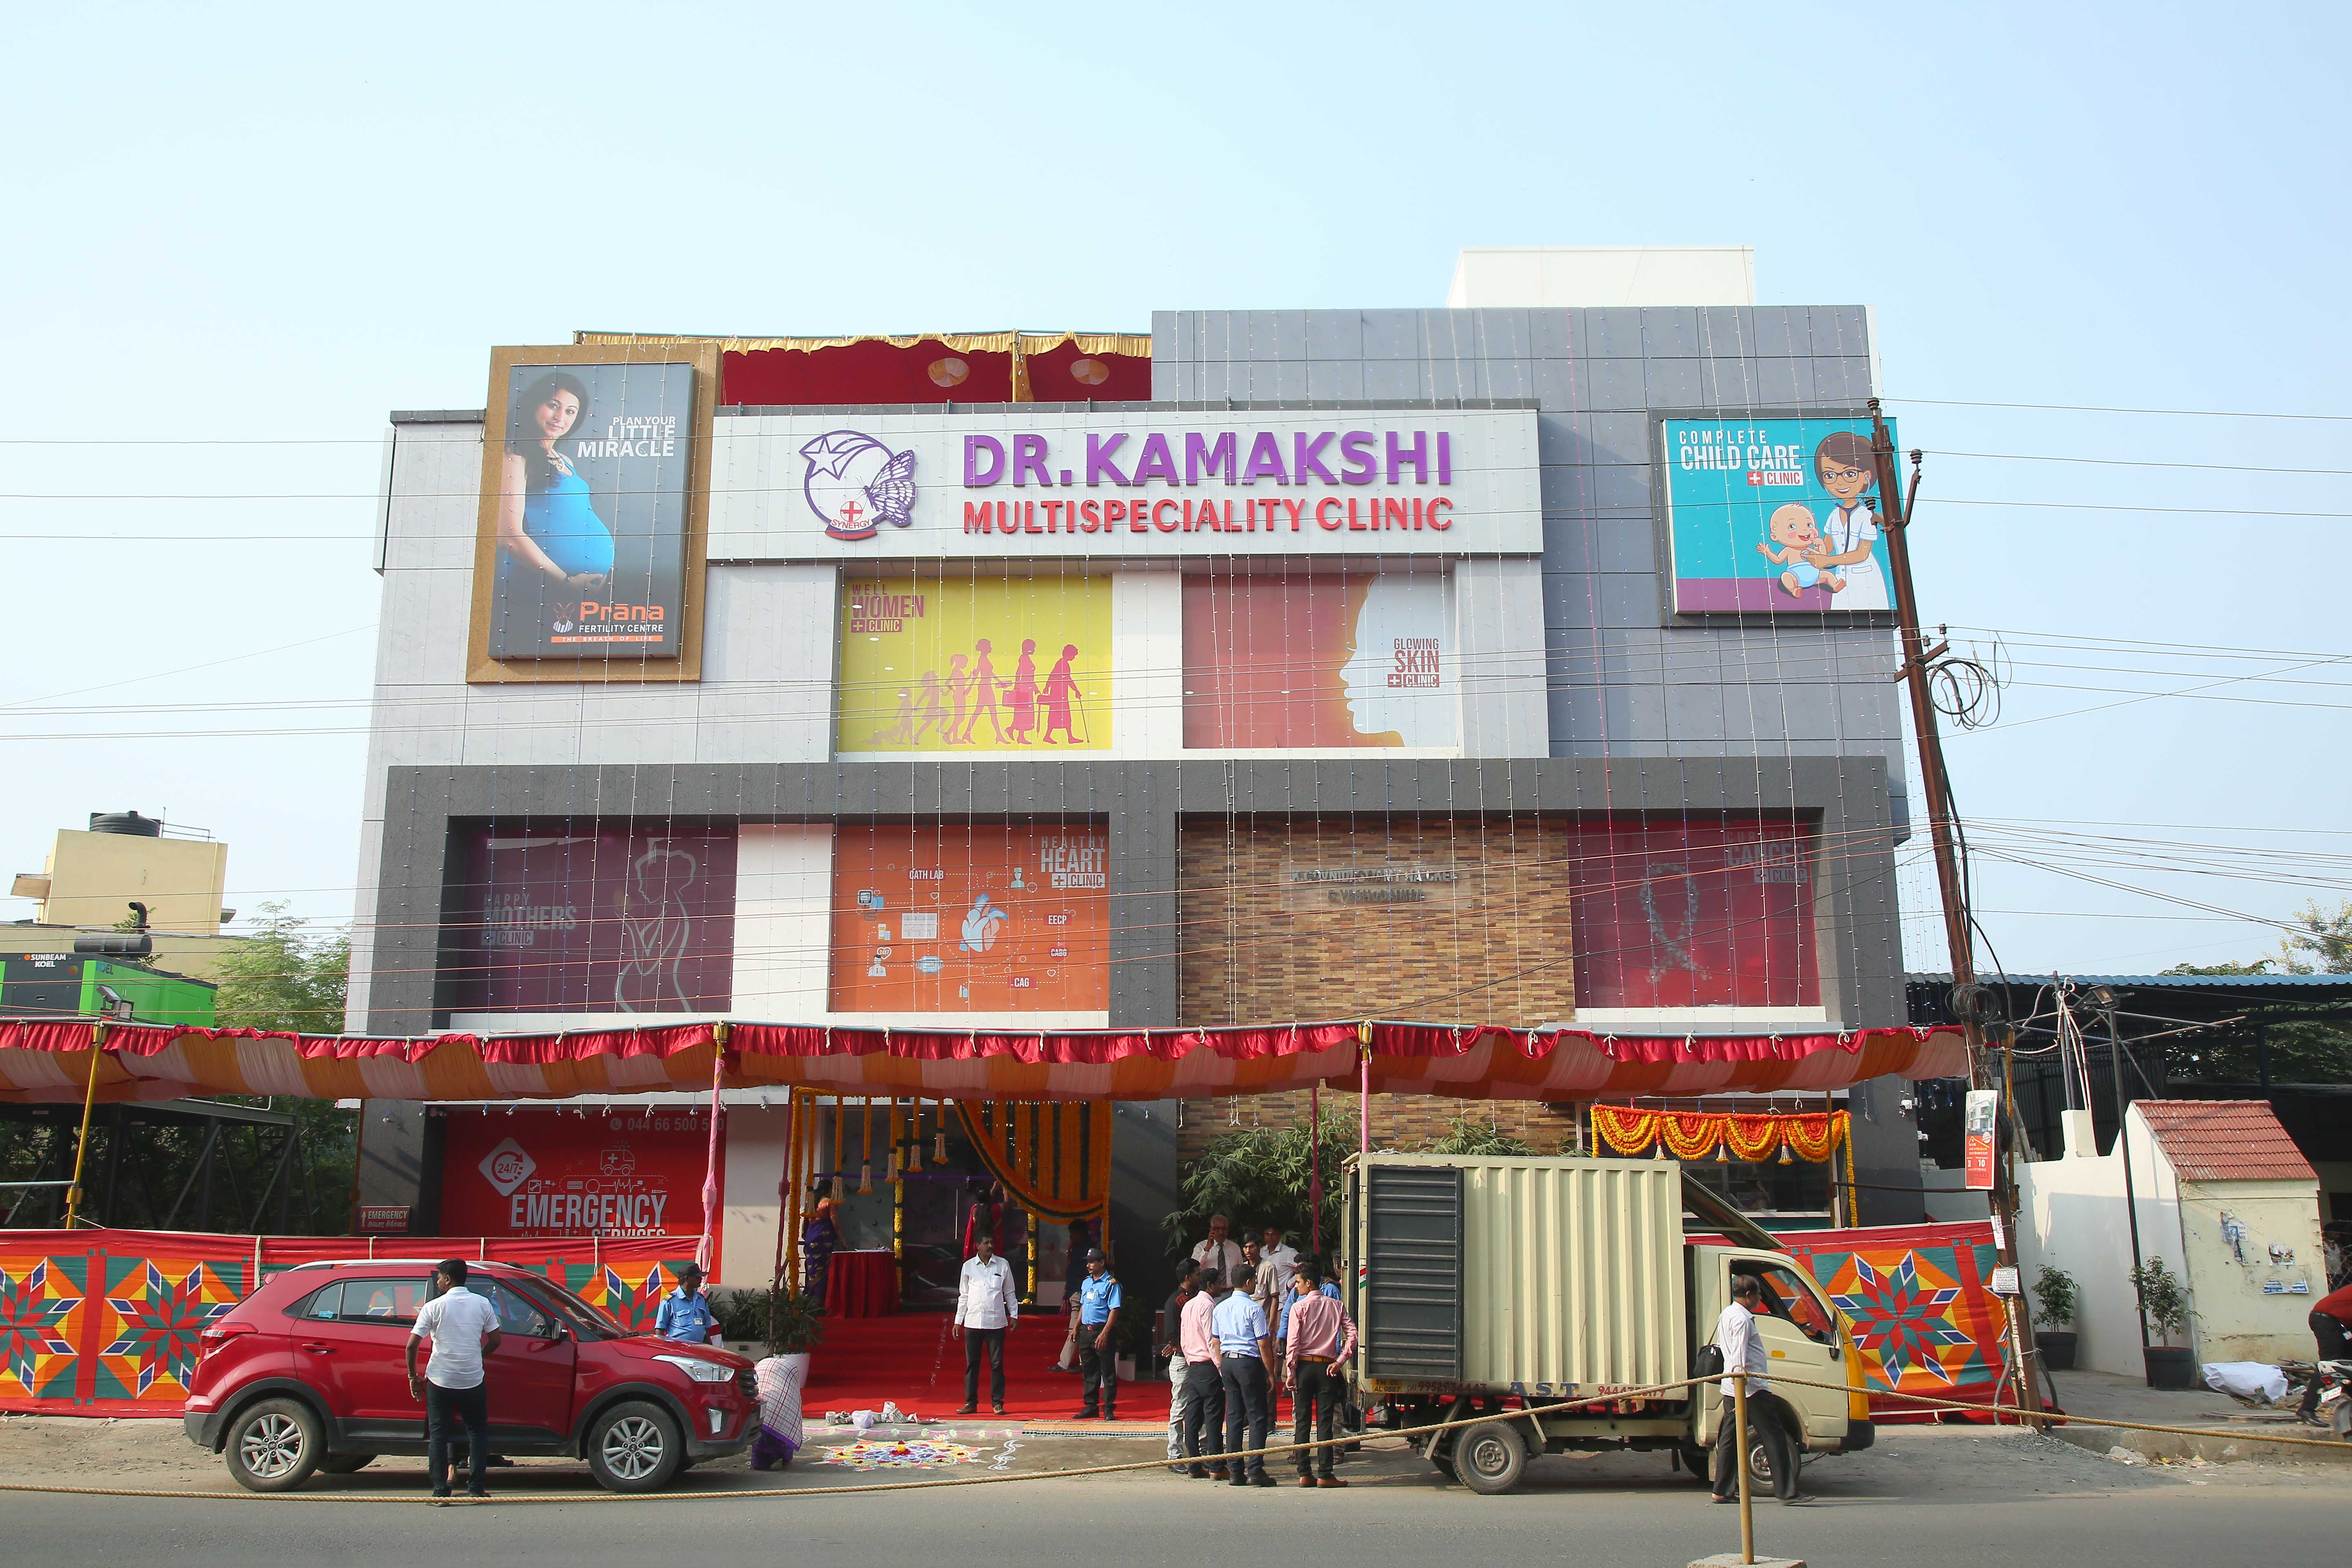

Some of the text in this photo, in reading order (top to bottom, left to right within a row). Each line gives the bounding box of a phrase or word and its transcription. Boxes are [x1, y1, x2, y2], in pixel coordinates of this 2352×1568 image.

[612, 416, 676, 425] PLAN YOUR
[608, 425, 675, 441] LITTLE
[1679, 430, 1766, 444] COMPLETE
[577, 441, 674, 458] MIRACLE
[1680, 445, 1801, 470] CHILD CARE
[1766, 472, 1801, 485] CLINIC
[964, 497, 1452, 534] MULTISPECIALITY CLINIC
[831, 519, 870, 529] SYNERGY
[852, 584, 887, 595] WELL
[852, 595, 924, 618] WOMEN
[579, 625, 625, 633] FERTILITY
[869, 619, 900, 631] CLINIC
[1394, 638, 1439, 650] GLOWING
[1394, 650, 1439, 673] SKIN
[1405, 675, 1437, 687] CLINIC
[1041, 836, 1105, 848] HEALTHY
[1727, 831, 1805, 843] CURATIVE
[1041, 849, 1105, 872] HEART
[1728, 843, 1806, 866] CANCER
[909, 870, 944, 879] CATH LAB
[1773, 869, 1804, 882] CLINIC
[1071, 875, 1102, 887] CLINIC
[484, 894, 530, 906] HAPPY
[483, 906, 577, 931] MOTHERS
[1048, 915, 1067, 924] EECP
[500, 932, 531, 944] CLINIC
[1014, 978, 1029, 987] CAG
[628, 1118, 724, 1131] 044 66 500 50
[498, 1163, 519, 1174] 24/7
[368, 1211, 408, 1219] EMERGENCY
[511, 1194, 667, 1228] EMERGENCY
